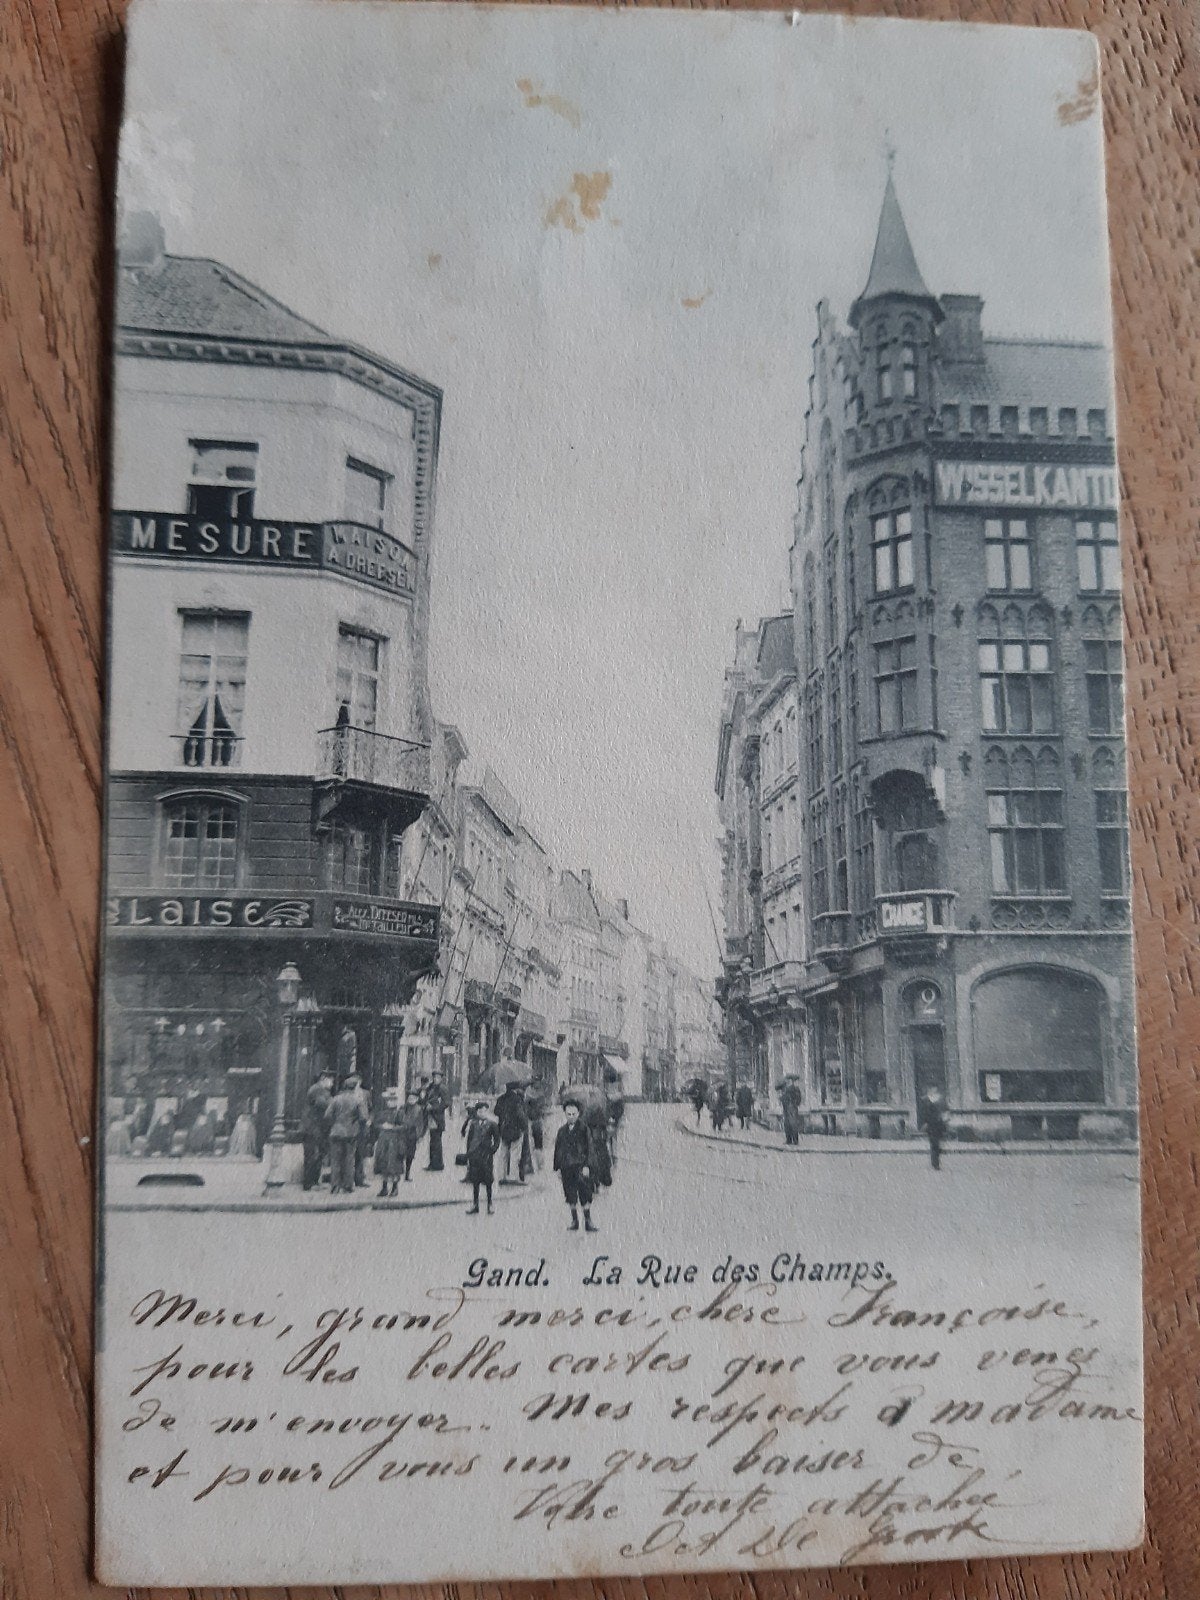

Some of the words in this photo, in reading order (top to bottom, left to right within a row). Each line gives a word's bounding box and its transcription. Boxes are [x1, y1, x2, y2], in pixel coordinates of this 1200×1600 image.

[131, 518, 315, 560] MESURE
[331, 525, 416, 571] MAISON
[921, 988, 936, 1014] 2
[463, 1257, 549, 1288] Gand.
[582, 1255, 621, 1286] La
[636, 1257, 698, 1288] Rue
[711, 1255, 760, 1283] des
[770, 1253, 892, 1288] Champs.
[130, 1289, 293, 1339] Merci,
[283, 1287, 466, 1375] grand
[130, 1344, 254, 1396] pour
[304, 1342, 359, 1383] les
[406, 1331, 521, 1380] belles
[548, 1331, 691, 1376] cartes
[710, 1353, 805, 1397] que
[836, 1352, 940, 1374] vous
[122, 1398, 177, 1432] de
[522, 1392, 633, 1420] Mes
[669, 1383, 850, 1448] respects
[127, 1448, 190, 1489] et
[192, 1463, 323, 1502] pour
[378, 1454, 480, 1482] vous
[503, 1454, 571, 1474] un
[586, 1450, 698, 1500] gros
[732, 1427, 865, 1475] baiser
[908, 1431, 980, 1470] de
